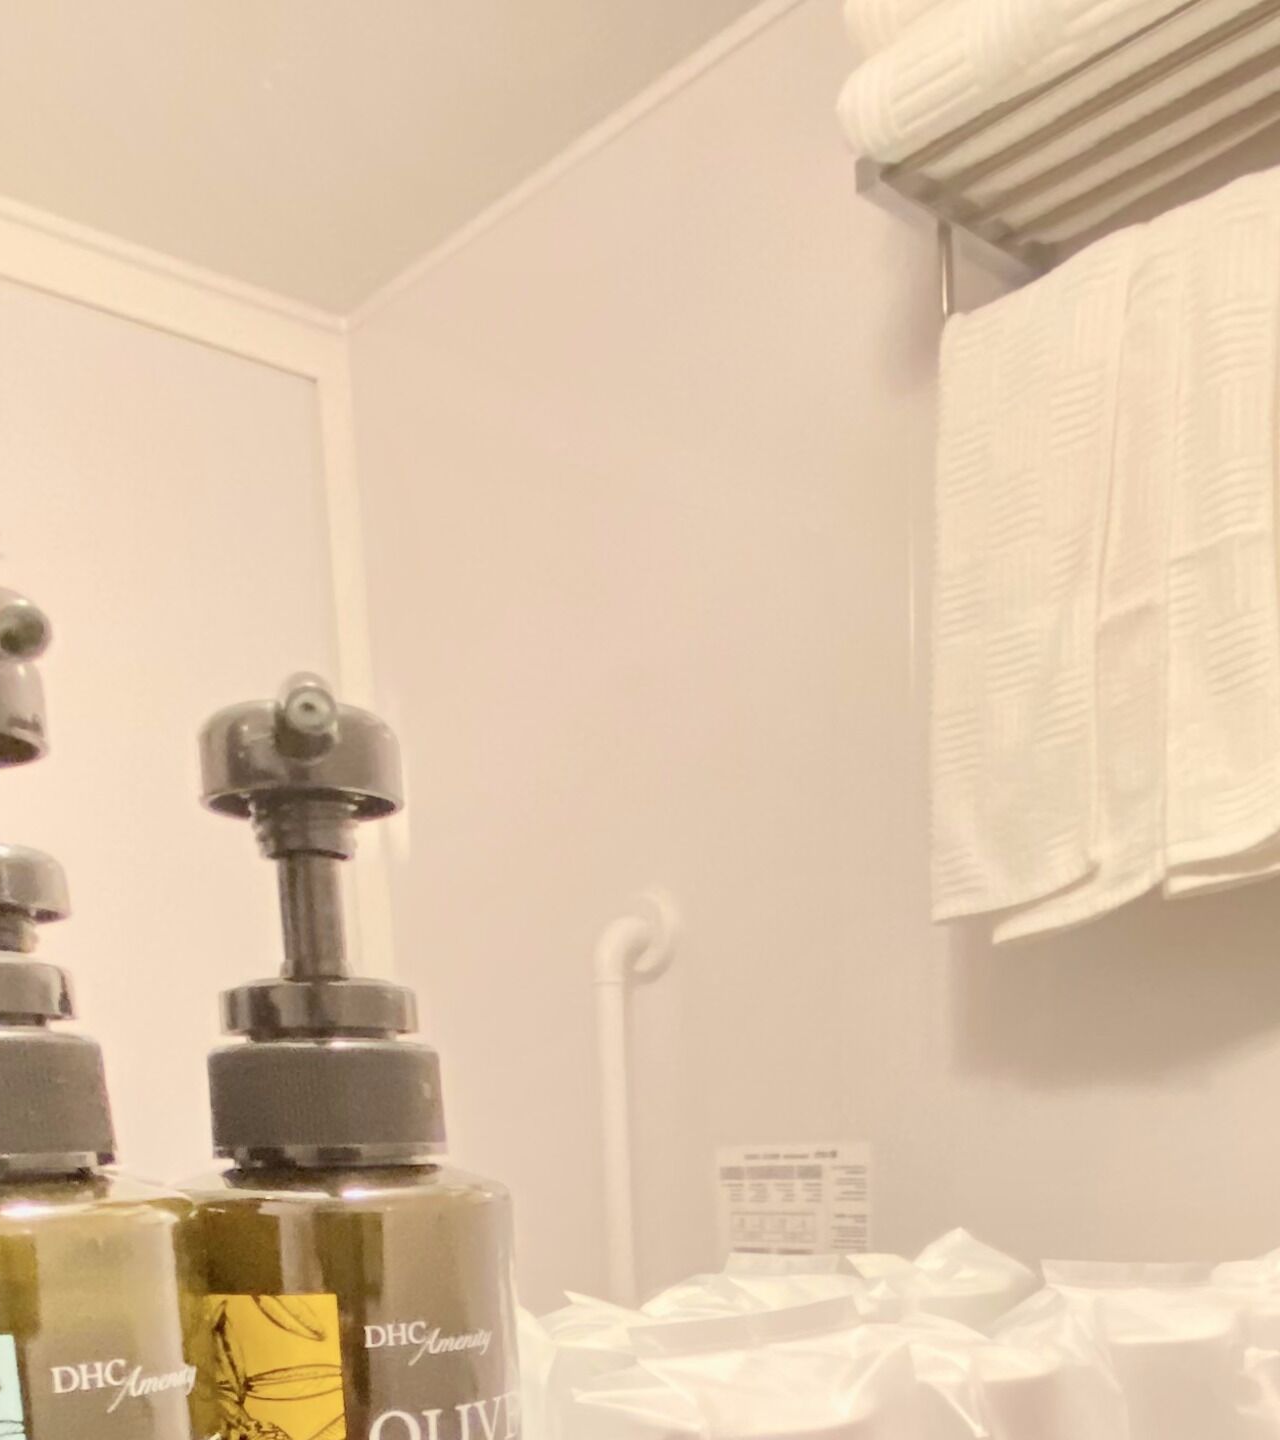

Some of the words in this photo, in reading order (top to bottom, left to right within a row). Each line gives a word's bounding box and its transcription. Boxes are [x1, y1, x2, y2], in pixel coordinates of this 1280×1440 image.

[364, 1320, 427, 1349] DHC
[407, 1327, 493, 1367] Amenity
[50, 1358, 127, 1394] DHC
[106, 1364, 198, 1414] Amenity
